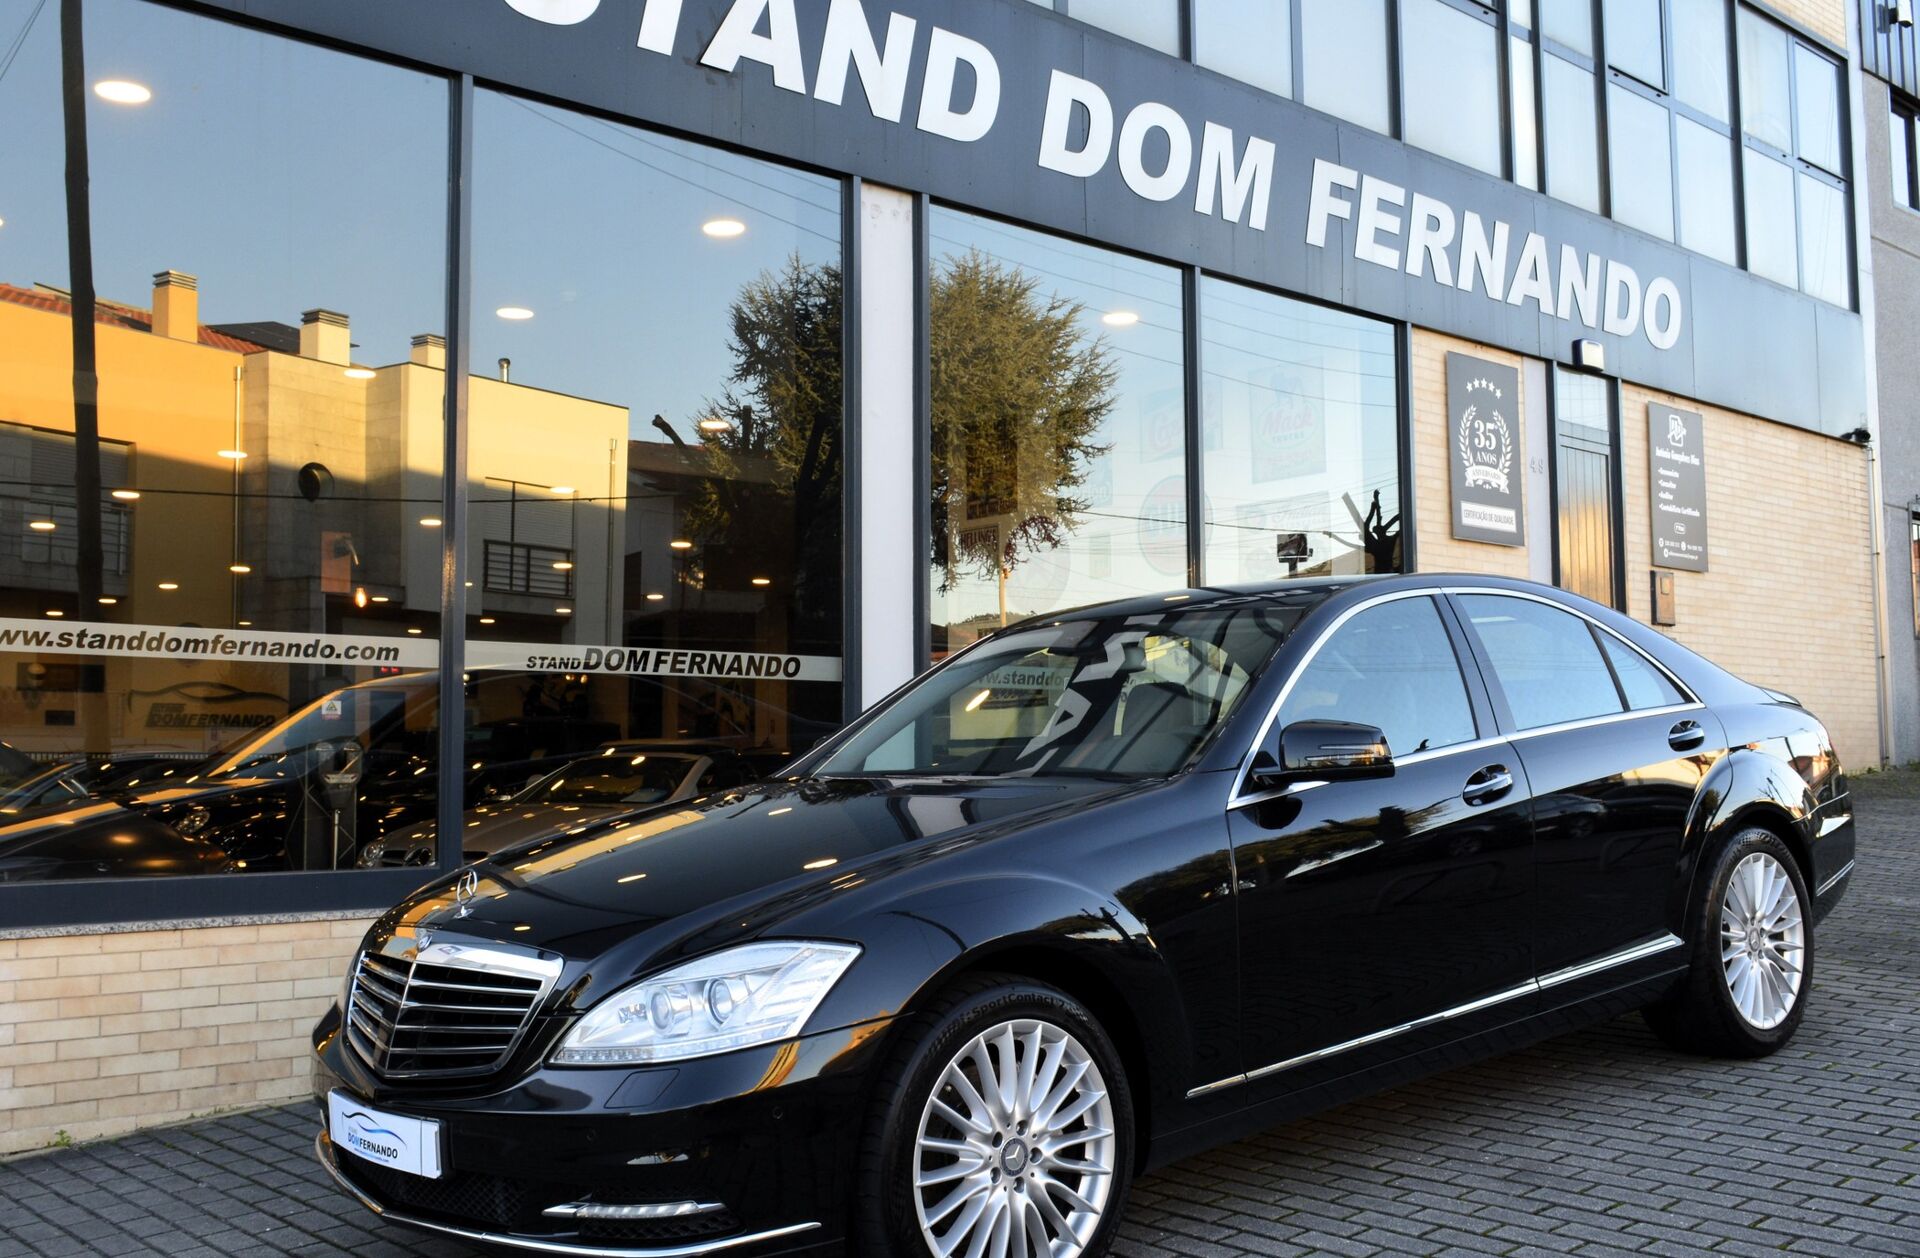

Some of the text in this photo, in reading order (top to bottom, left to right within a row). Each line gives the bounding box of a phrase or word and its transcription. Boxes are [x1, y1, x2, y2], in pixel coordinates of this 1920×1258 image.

[504, 0, 1683, 350] AND DOM FERNANDO
[1475, 451, 1498, 466] ANOS
[526, 655, 581, 670] STAND
